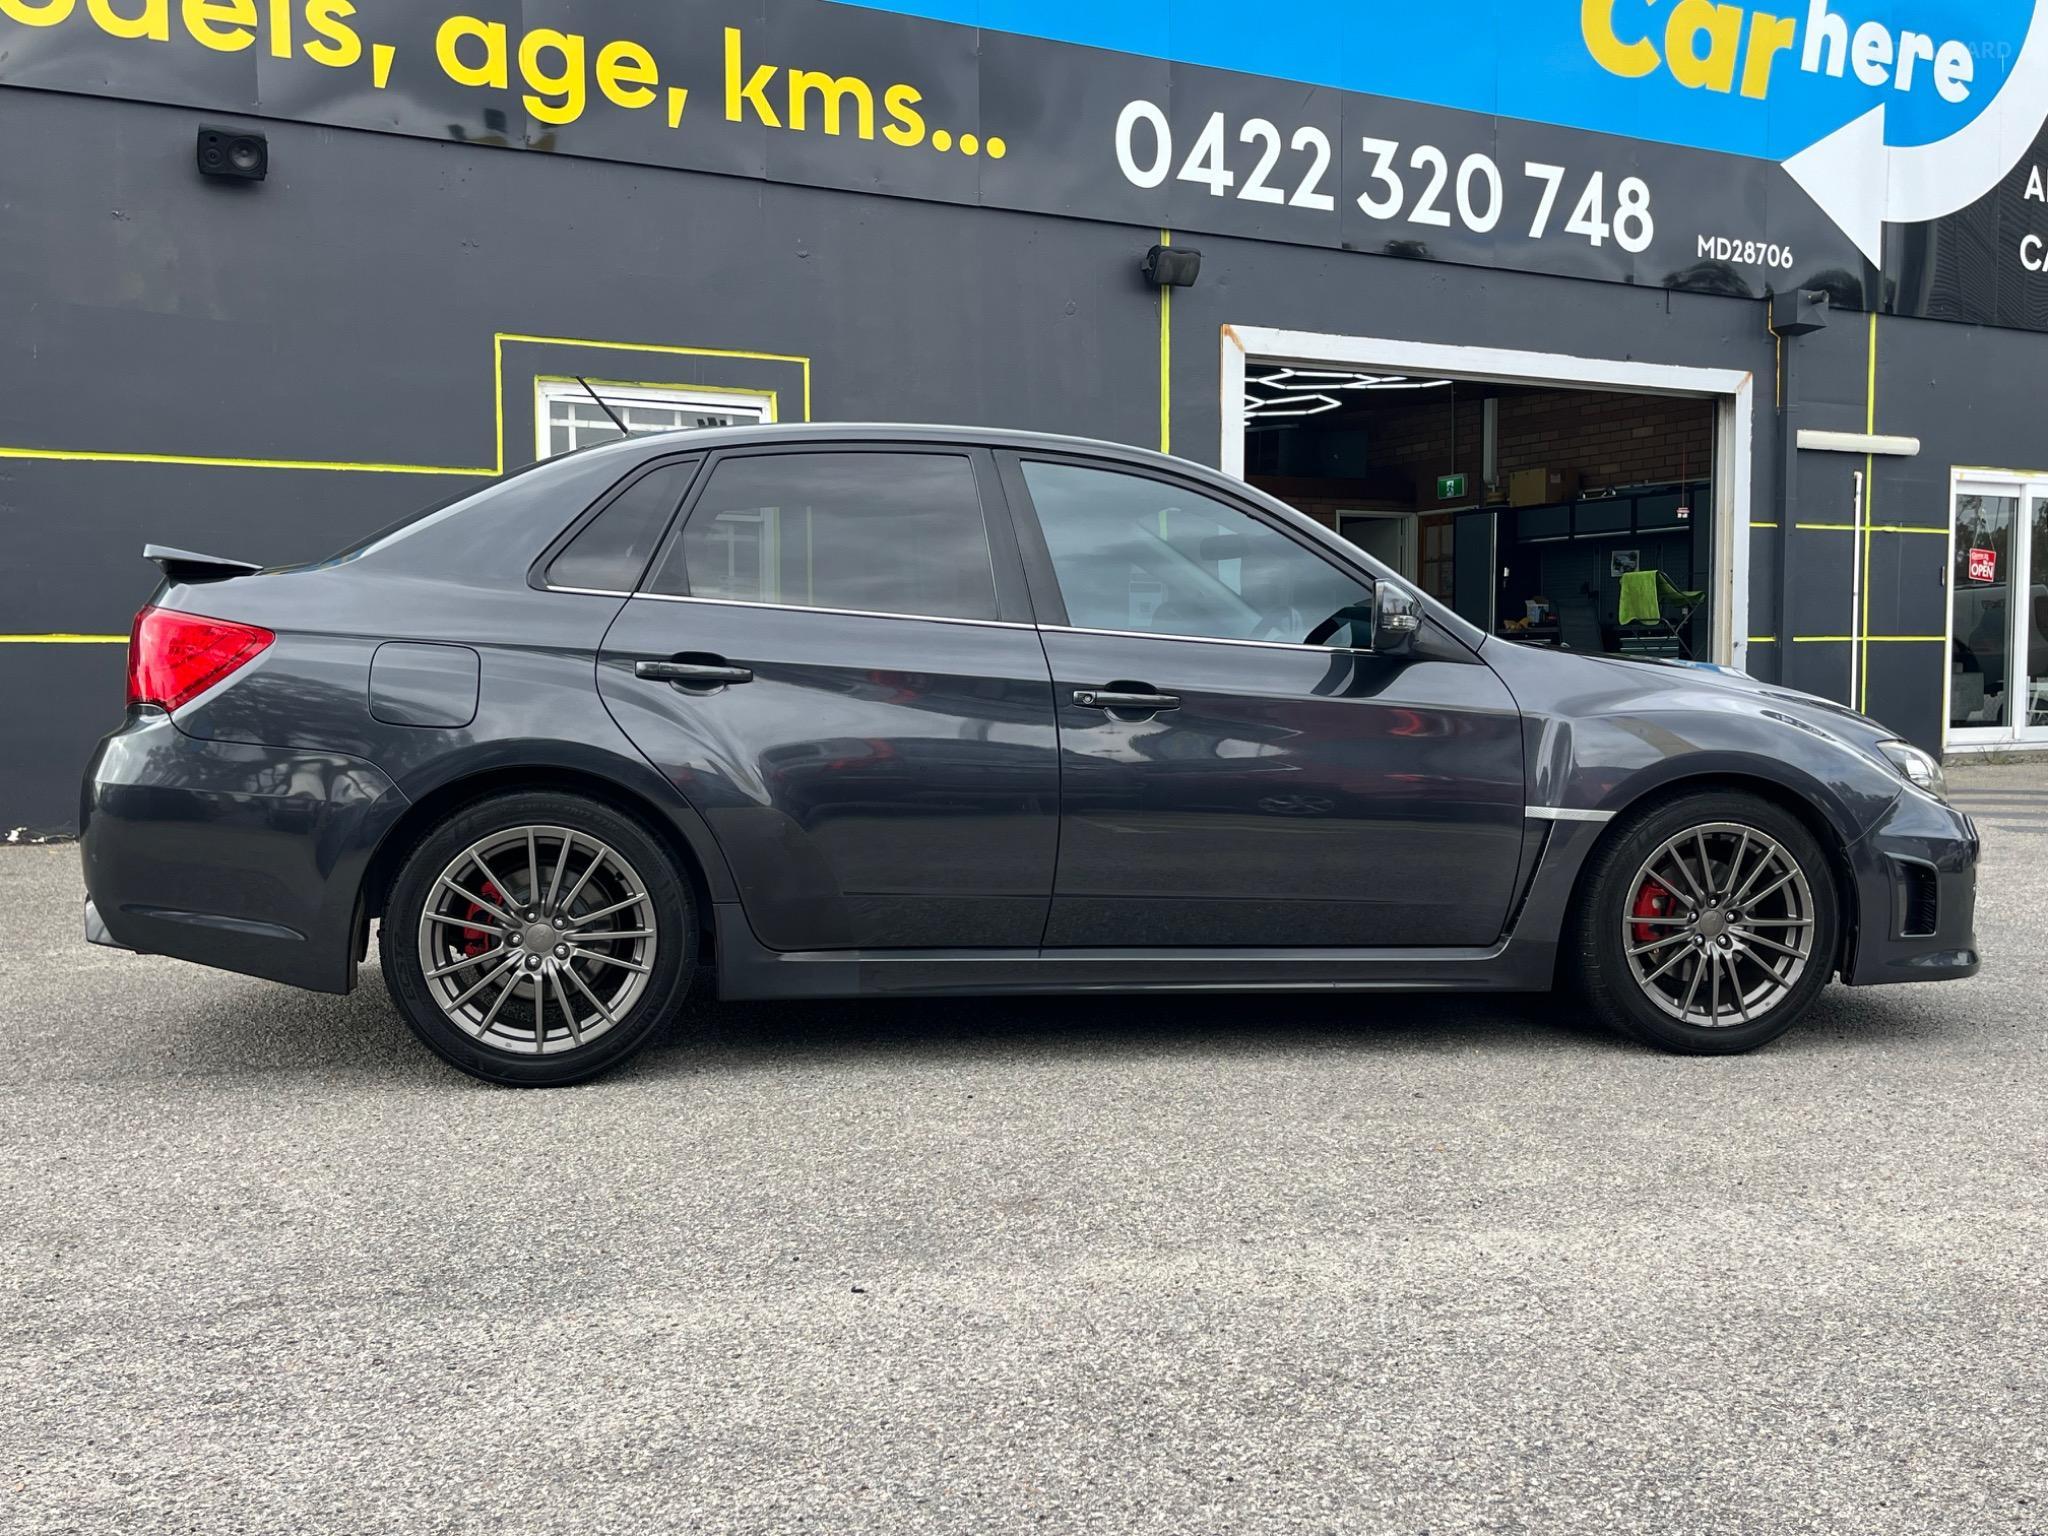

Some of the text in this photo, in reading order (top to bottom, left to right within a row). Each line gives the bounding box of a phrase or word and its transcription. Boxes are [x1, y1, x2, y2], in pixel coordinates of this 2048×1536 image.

[436, 16, 687, 128] age,
[725, 28, 1005, 158] kms...
[1582, 0, 1973, 103] Car here
[1115, 100, 1653, 252] 0422 320 748
[1697, 234, 1793, 268] MD28706
[1972, 564, 1993, 578] OPEN
